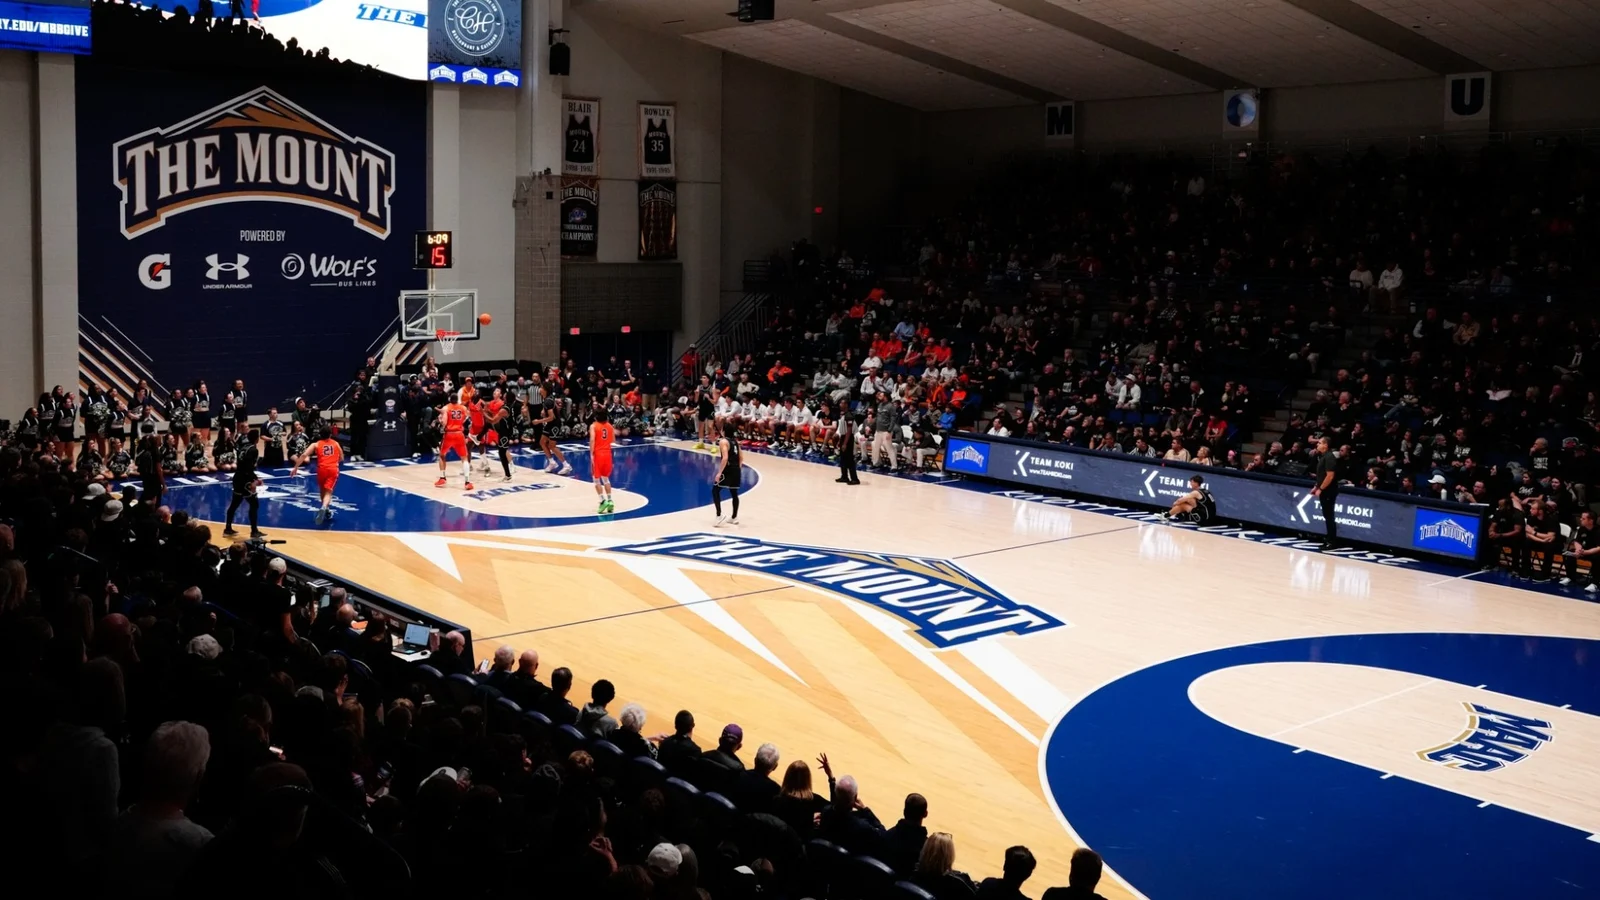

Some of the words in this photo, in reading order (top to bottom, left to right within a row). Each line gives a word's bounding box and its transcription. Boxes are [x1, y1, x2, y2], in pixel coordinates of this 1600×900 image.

[357, 4, 416, 25] THE
[0, 18, 89, 37] Y.EDU/MBBGIVE
[1450, 77, 1486, 116] U
[568, 102, 592, 113] BLAIR
[1047, 106, 1073, 136] M
[572, 139, 586, 153] 24
[651, 140, 664, 152] 35
[126, 134, 221, 215] THE
[235, 132, 386, 219] MOUNT
[574, 187, 597, 202] MOUNT
[240, 230, 275, 241] POWERED
[276, 230, 286, 241] BY
[427, 233, 448, 244] 6:09
[561, 231, 594, 241] CHAMPIONS
[138, 253, 171, 290] G
[309, 253, 377, 278] WOLF'S
[602, 428, 608, 438] 3
[323, 445, 334, 456] 21
[1030, 456, 1052, 467] TEAM
[1054, 460, 1074, 470] KOKI
[1159, 476, 1184, 487] TEAM
[1186, 480, 1209, 490] KKI
[1314, 500, 1343, 513] TM
[1347, 505, 1373, 518] KOKI
[1420, 524, 1440, 540] THE
[1440, 524, 1474, 549] MOUNT
[622, 534, 828, 568] THE
[782, 560, 1051, 642] MOUNT
[1425, 702, 1554, 773] MAAC
